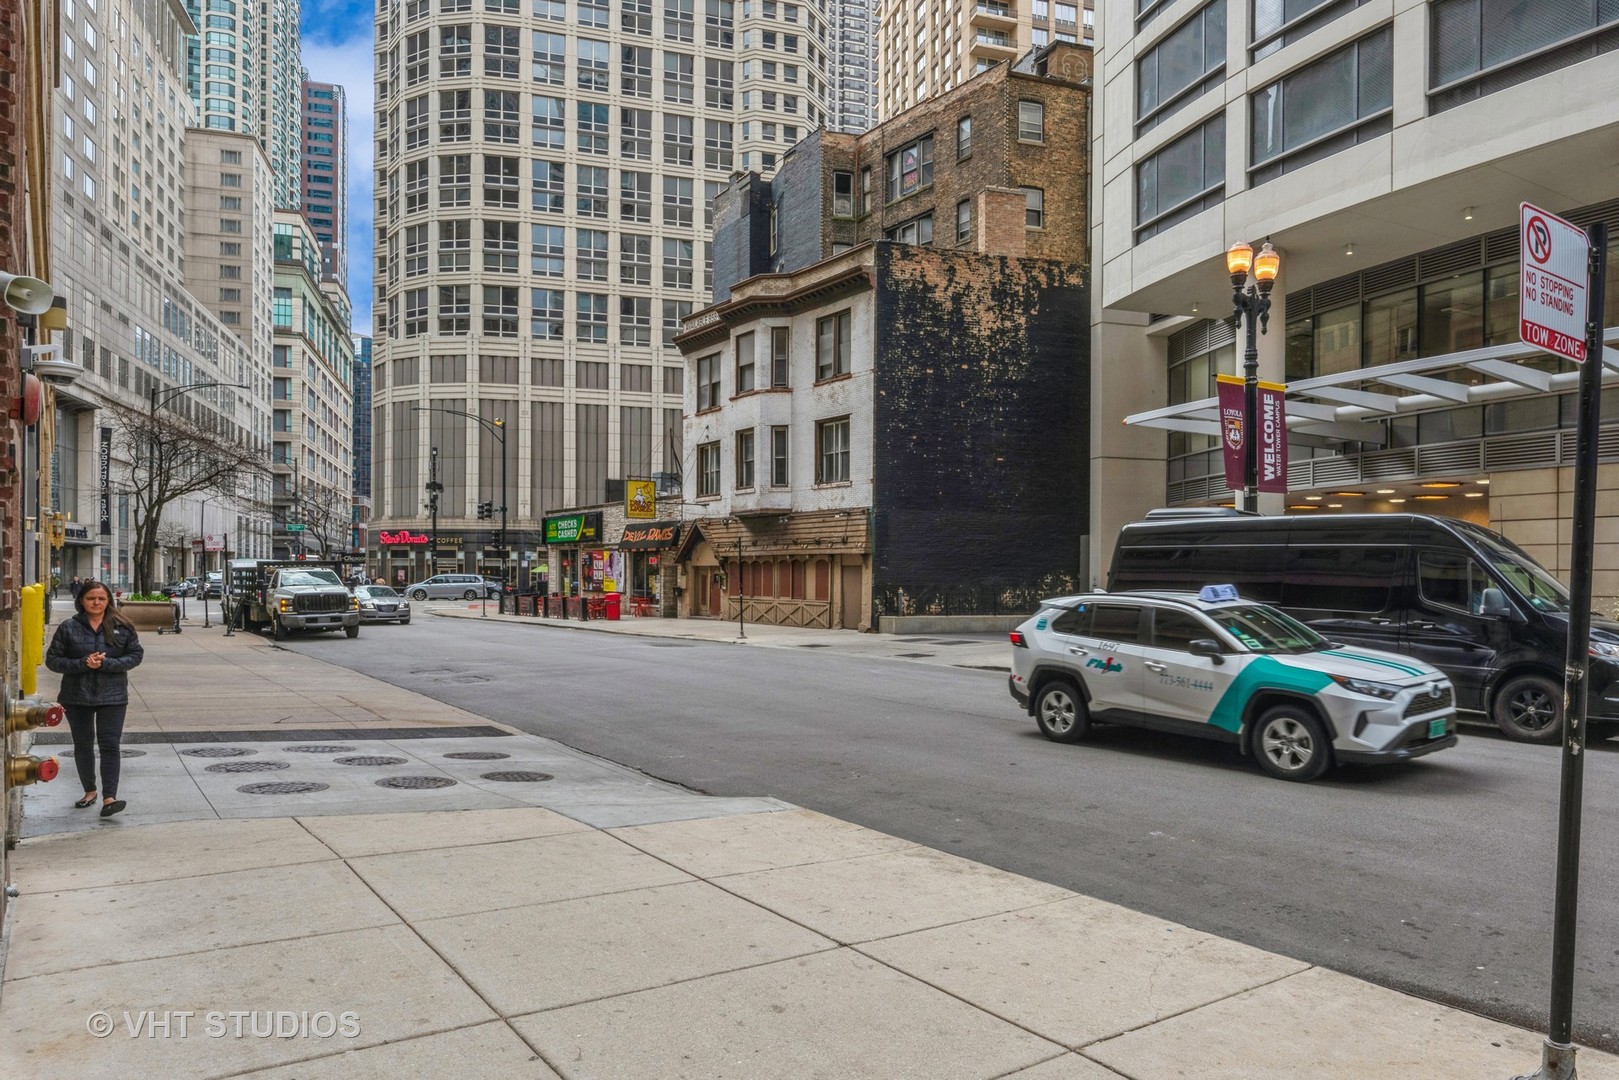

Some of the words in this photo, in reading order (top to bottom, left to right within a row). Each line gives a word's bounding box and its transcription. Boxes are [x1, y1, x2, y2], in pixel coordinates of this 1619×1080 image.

[1526, 271, 1536, 285] NO
[1540, 276, 1573, 300] STOPPING
[1526, 286, 1536, 301] NO
[1540, 292, 1573, 316] STANDING
[1525, 322, 1548, 346] TOW
[1554, 333, 1581, 358] ZONE
[1223, 408, 1243, 417] LOYOLA
[1264, 394, 1275, 481] WELCOME
[558, 519, 577, 530] CHECKS
[558, 529, 578, 539] CASHED
[623, 530, 647, 543] DEVIL
[646, 527, 674, 541] DAWGS
